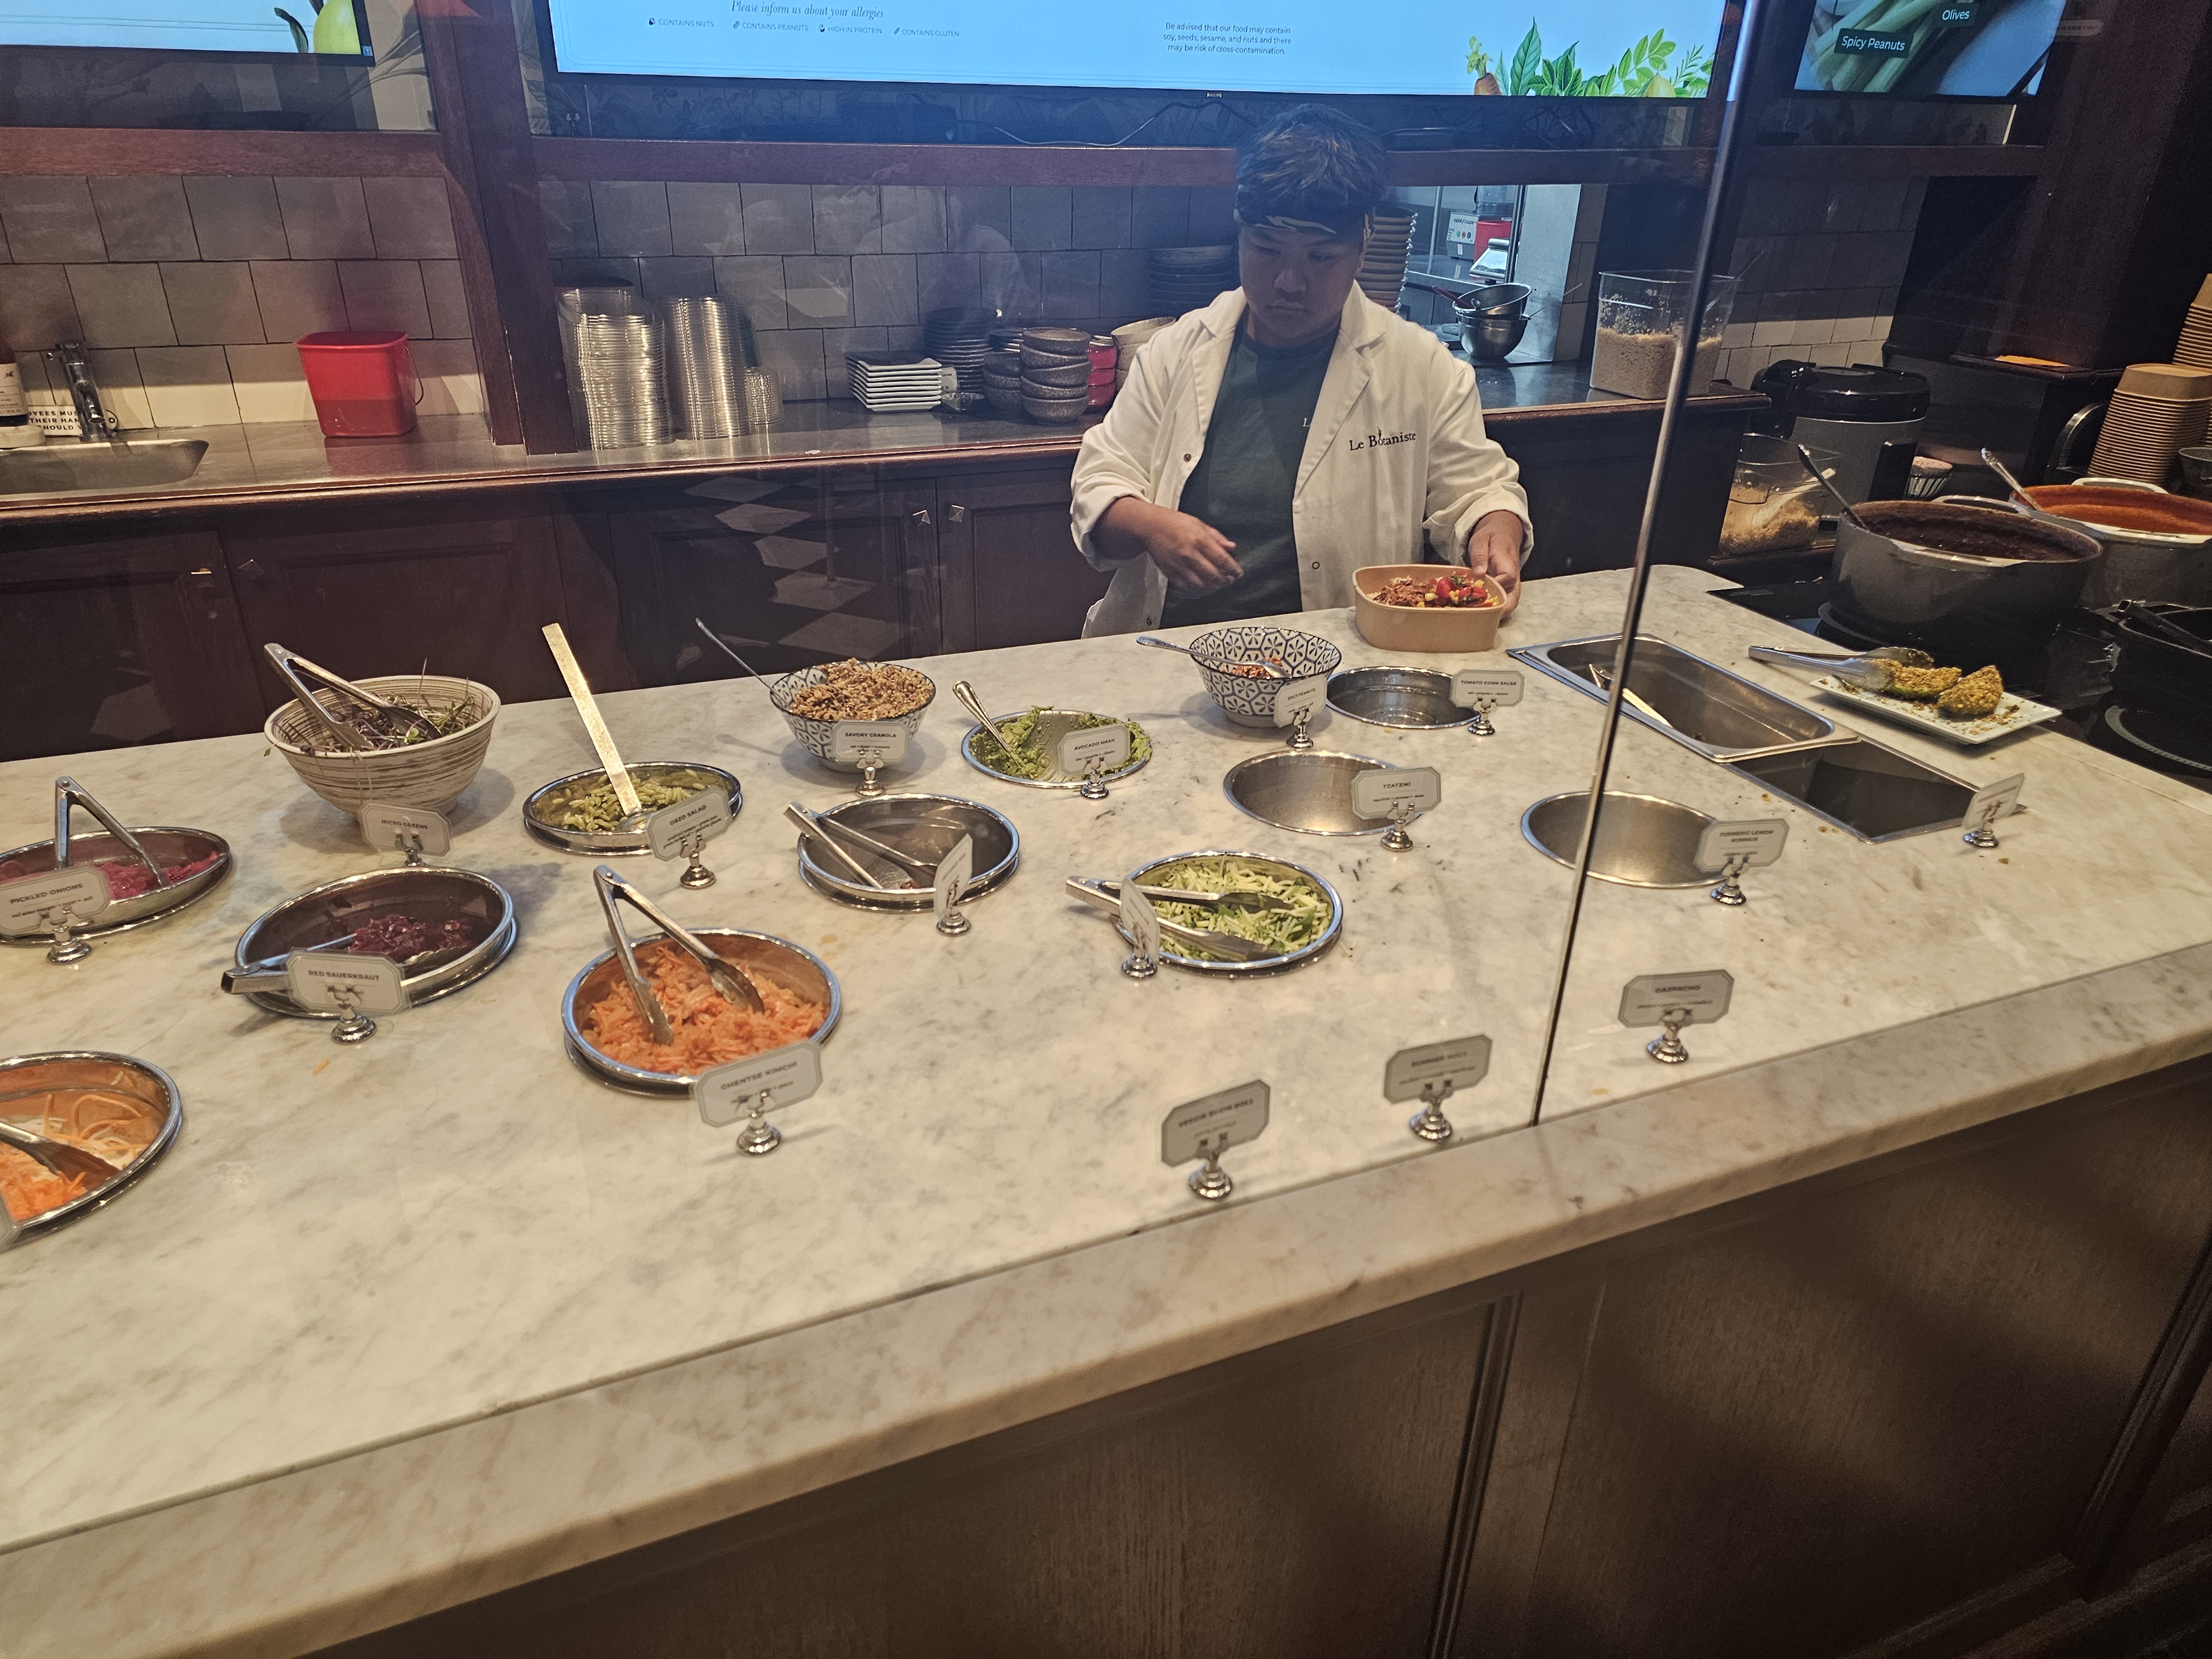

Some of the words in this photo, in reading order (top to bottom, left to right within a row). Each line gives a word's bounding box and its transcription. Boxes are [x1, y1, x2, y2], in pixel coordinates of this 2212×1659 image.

[731, 0, 758, 12] Please
[761, 2, 789, 15] inform
[804, 4, 828, 15] about
[828, 8, 848, 19] your
[851, 6, 884, 20] allergies
[1942, 9, 1970, 20] Olives
[658, 19, 694, 27] CONTAINS
[778, 24, 809, 32] PEANUTS
[1232, 24, 1248, 33] food
[1178, 34, 1199, 43] seeds,
[1841, 36, 1867, 49] Spicy
[1867, 38, 1905, 51] Peanuts
[1349, 440, 1364, 451] Le
[1368, 431, 1416, 448] Botaniste
[1074, 741, 1099, 751] AVOCADO
[669, 815, 686, 826] ORZO
[687, 805, 707, 817] SALAD
[9, 891, 48, 904] PICKLED
[50, 883, 84, 895] ONIONS
[326, 972, 380, 981] SAUERKRAUT
